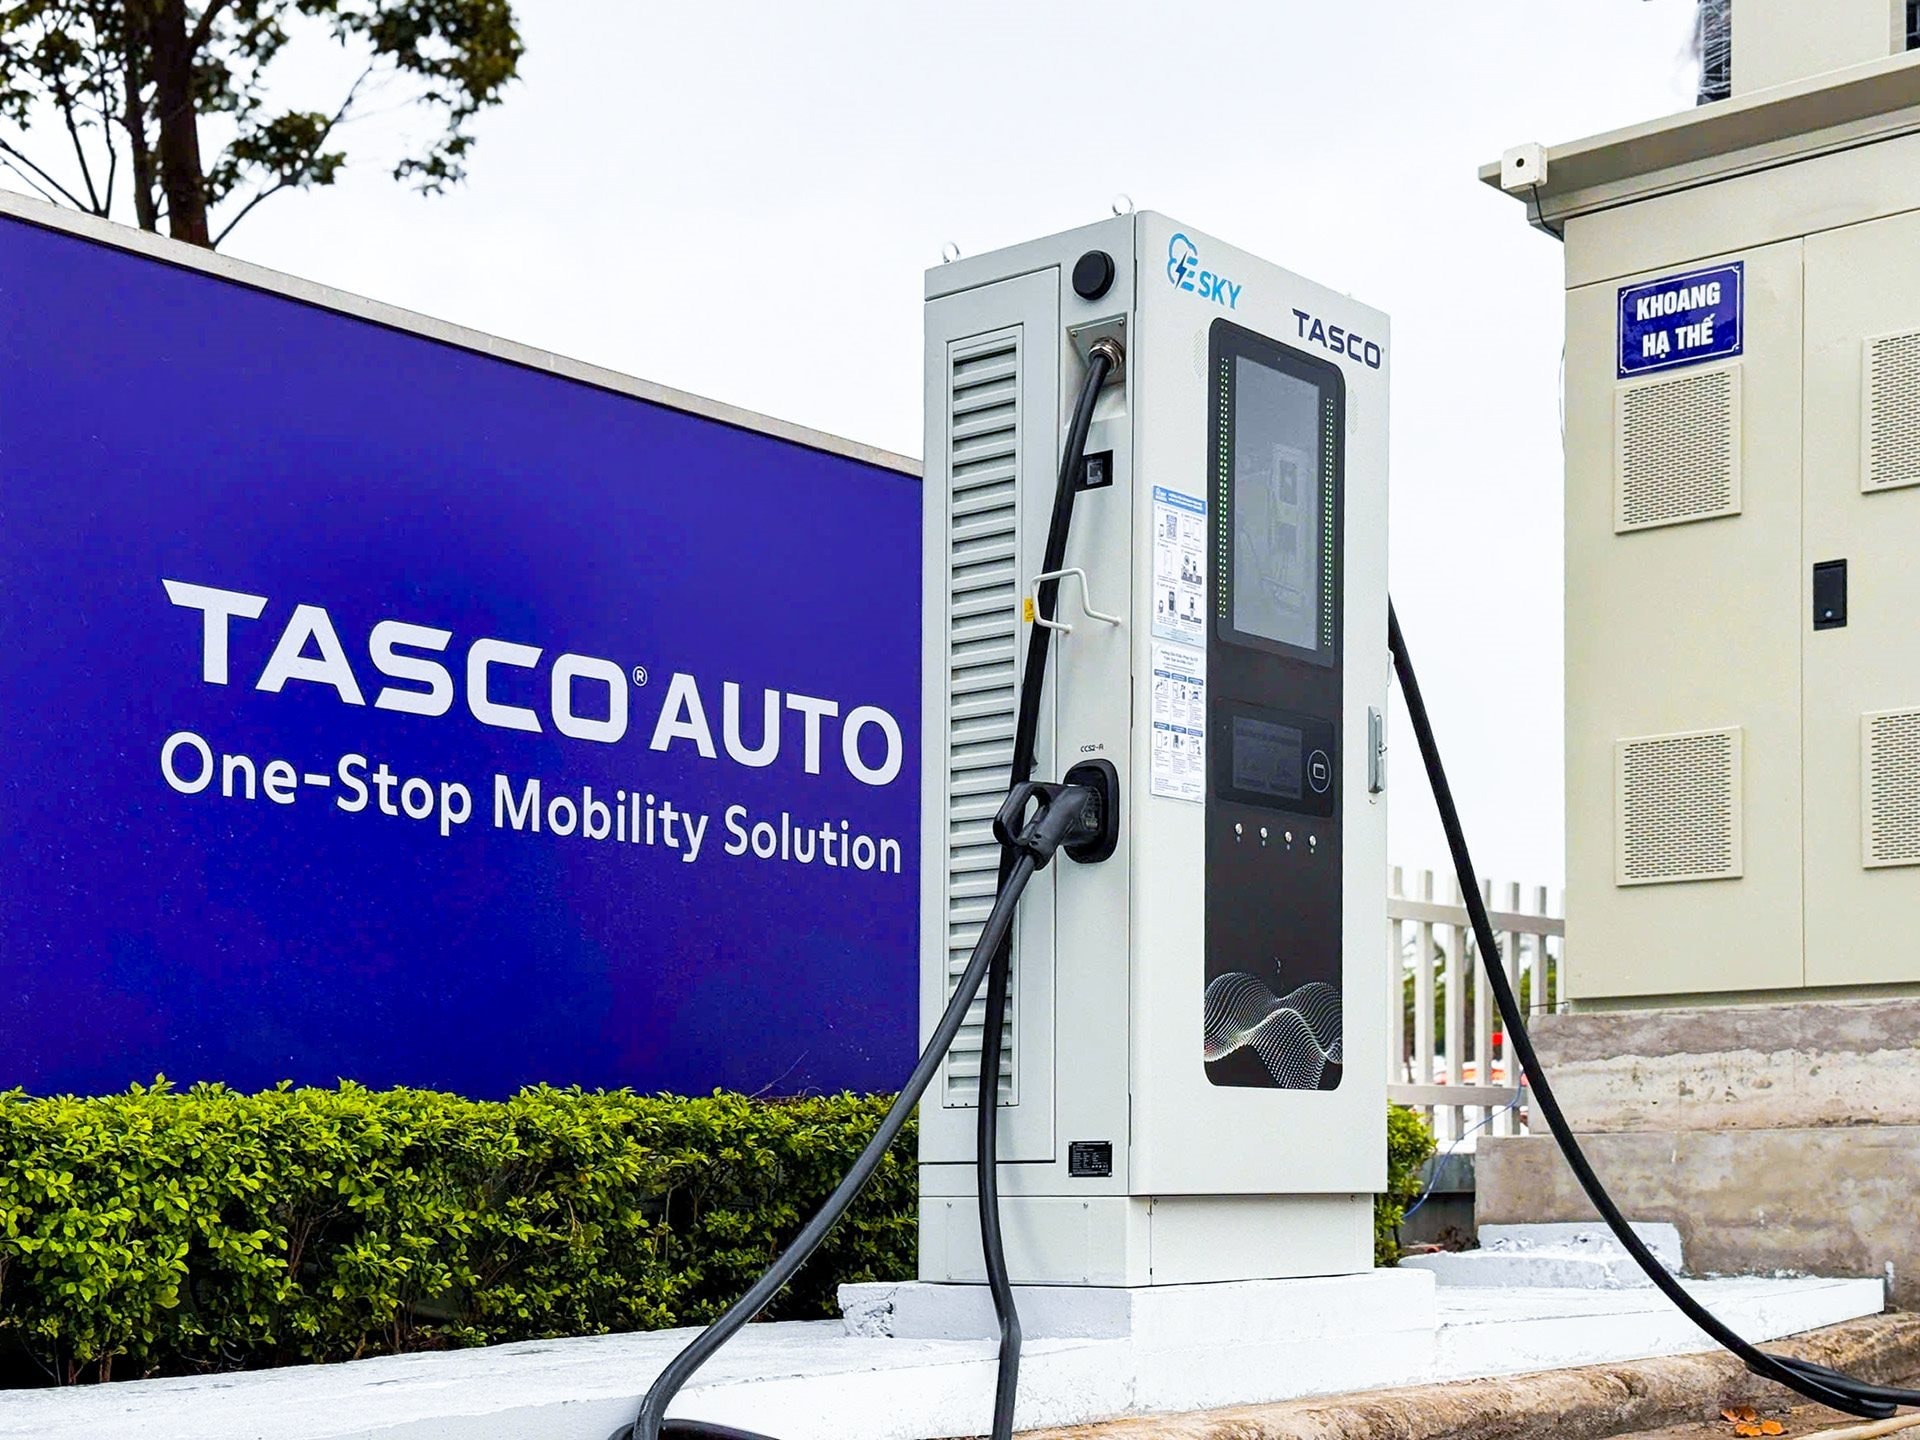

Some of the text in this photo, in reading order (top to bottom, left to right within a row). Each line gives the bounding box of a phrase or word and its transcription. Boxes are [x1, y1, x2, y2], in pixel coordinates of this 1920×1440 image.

[1636, 281, 1721, 321] KHOANG
[1292, 308, 1381, 369] TASCO
[1642, 313, 1715, 359] HẠ THẾ
[649, 672, 903, 786] AUTO
[160, 731, 901, 874] One-Stop Mobility Solution
